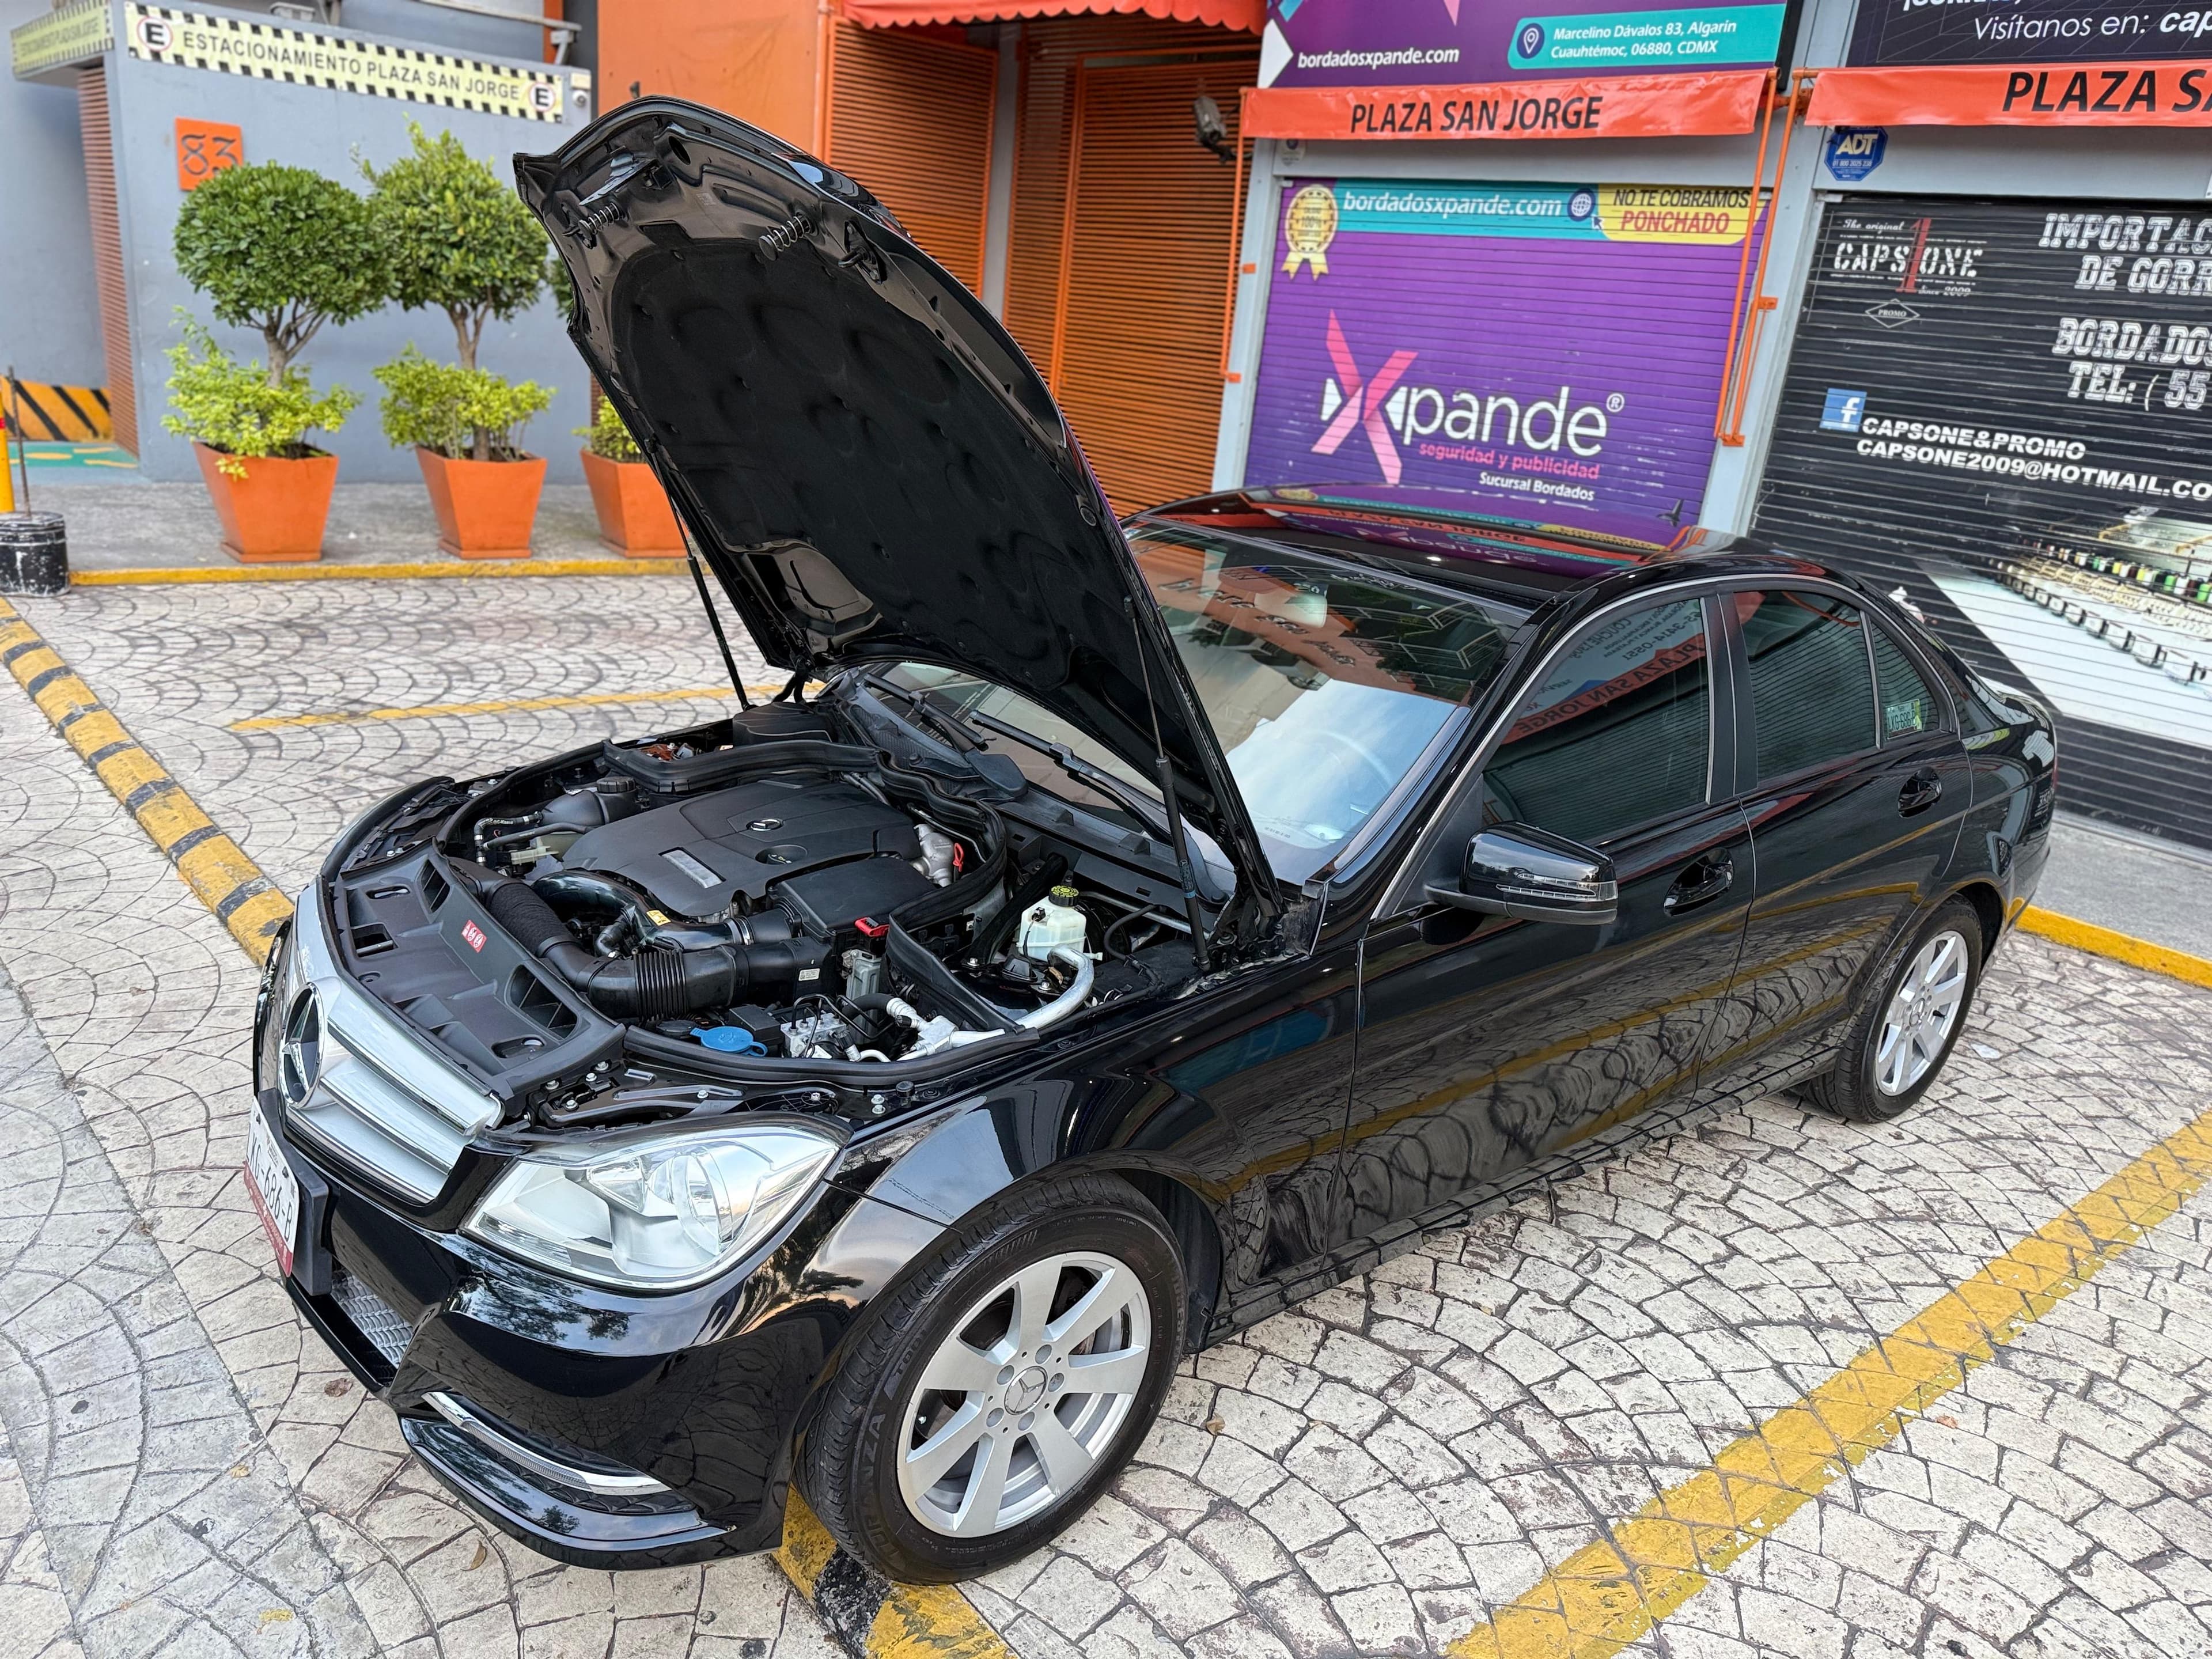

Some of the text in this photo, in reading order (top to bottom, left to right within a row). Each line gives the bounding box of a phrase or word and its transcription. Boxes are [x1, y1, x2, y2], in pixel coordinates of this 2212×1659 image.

[145, 22, 165, 46] E
[1553, 26, 1611, 40] Marcelino
[1613, 23, 1662, 39] Dávalos
[1665, 23, 1684, 37] 83,
[1975, 14, 2091, 40] Visítanos
[2101, 15, 2149, 35] en:
[1298, 47, 1460, 70] bordadosxpande.com
[1551, 40, 1719, 59] Cuauhtémoc, 06880, CDMX
[184, 31, 520, 100] ESTACIONAMIENTO PLAZA SAN JORGE
[535, 87, 550, 107] E
[2002, 69, 2212, 112] PLAZA S
[1351, 96, 1604, 133] PLAZA SAN JORGE
[181, 134, 238, 175] 83
[1835, 134, 1878, 155] ADT
[1343, 191, 1562, 219] bordadosxpande.com
[1613, 190, 1751, 208] NO TE COBRAMOS
[1621, 211, 1730, 234] PONCHADO
[1844, 219, 1904, 234] The original
[2039, 213, 2212, 254] IMPORTAC
[2074, 255, 2124, 291] DE
[1943, 286, 1971, 297] 2009
[1878, 308, 1907, 317] PROMO
[2067, 361, 2136, 404] TEL:
[2164, 368, 2211, 410] 55
[1862, 417, 2086, 460] CAPSONE&PROMO
[1419, 442, 1600, 480] seguridad y publicidad
[1857, 439, 2212, 501] CAPSONE2009@HOTMAIL.CO
[1479, 471, 1595, 502] Sucursal Bordados
